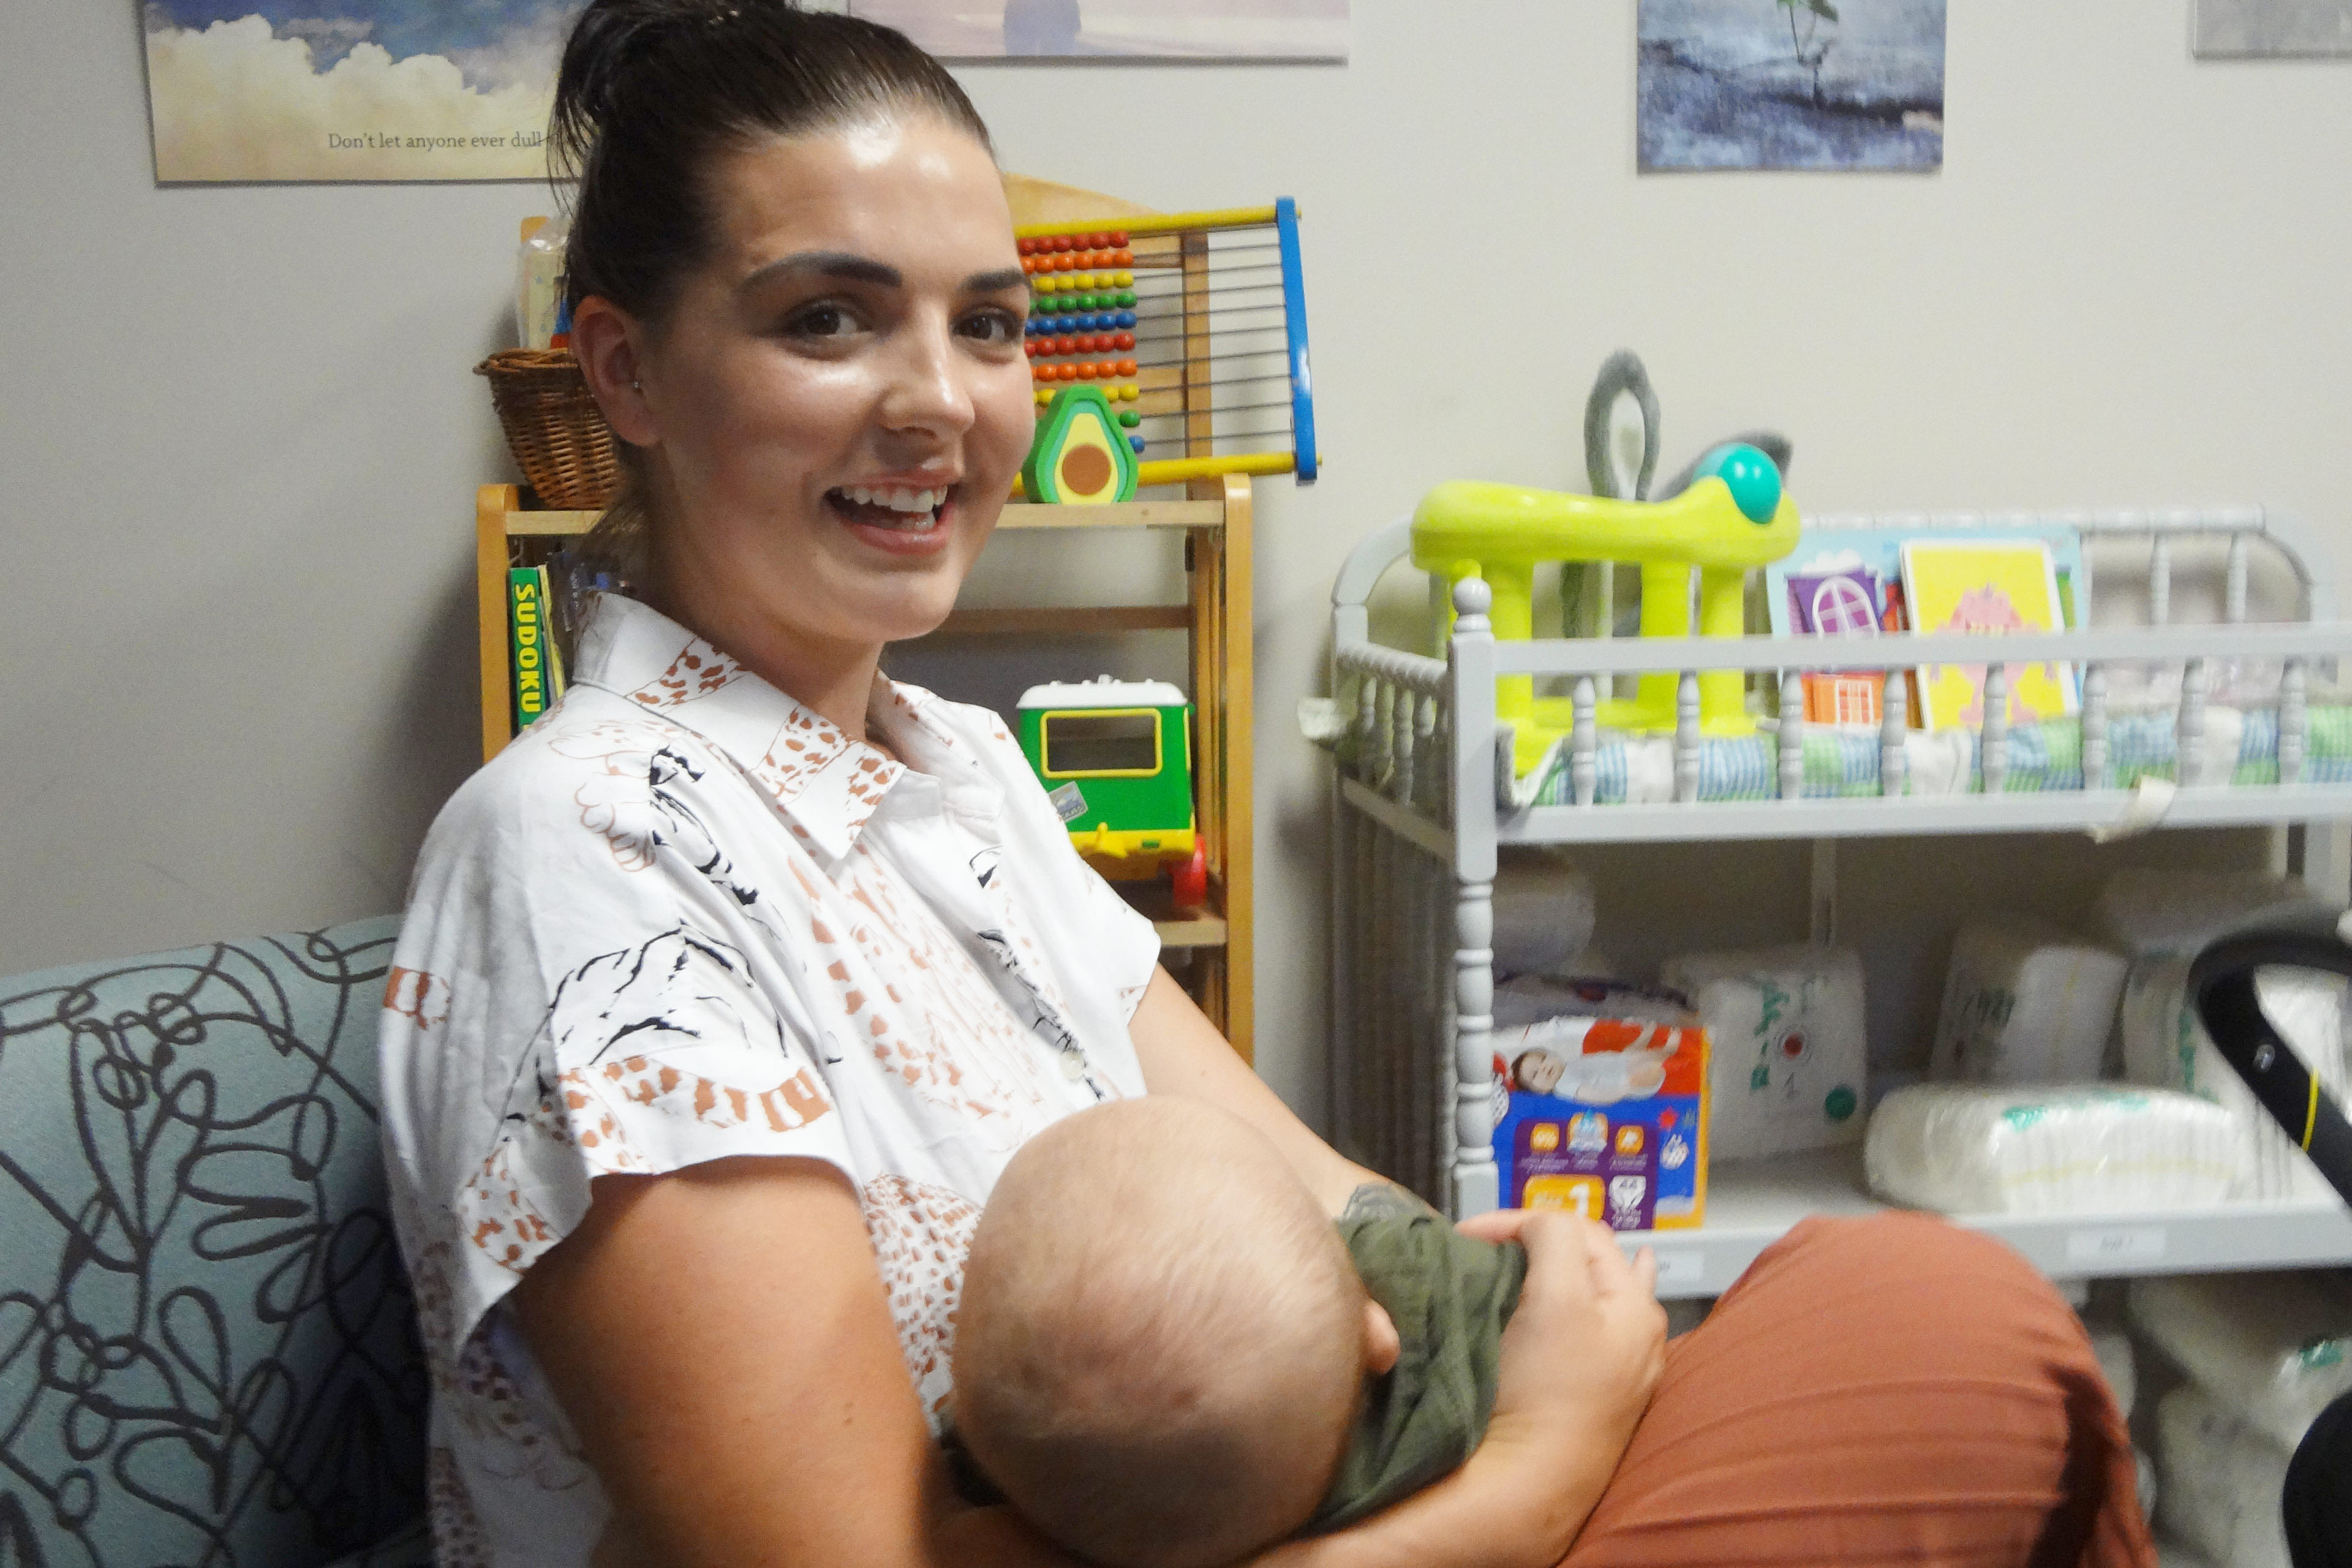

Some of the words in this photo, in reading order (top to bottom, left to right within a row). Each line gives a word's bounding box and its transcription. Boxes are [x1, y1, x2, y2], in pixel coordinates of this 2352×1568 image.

[328, 132, 374, 148] Don't
[379, 132, 401, 148] let
[406, 136, 466, 152] anyone
[471, 137, 504, 148] ever
[511, 131, 541, 148] dull
[515, 584, 541, 713] SUDOKU
